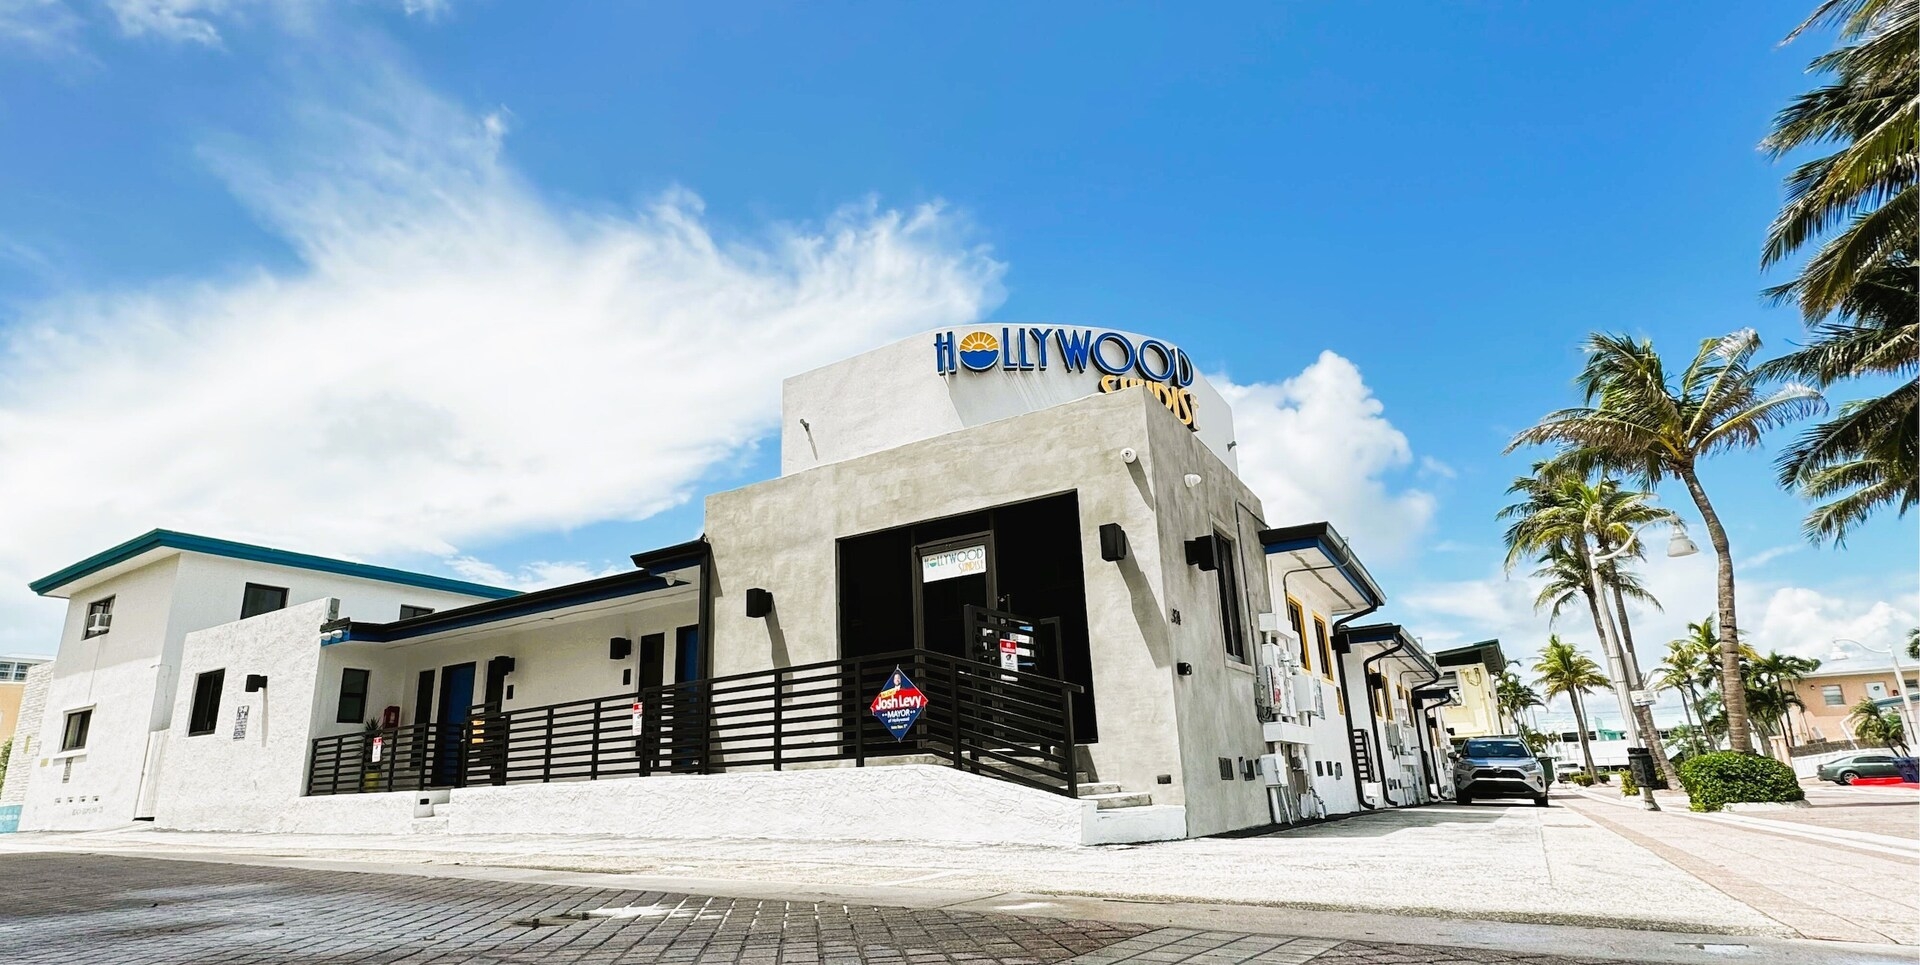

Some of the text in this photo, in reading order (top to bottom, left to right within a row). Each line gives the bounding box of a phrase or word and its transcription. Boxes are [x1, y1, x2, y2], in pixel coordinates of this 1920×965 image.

[934, 327, 1194, 388] HOLLYWOOD
[1099, 375, 1200, 431] SRISE
[924, 548, 983, 568] HOLLYWOOD
[875, 695, 922, 710] Josh Levy
[887, 709, 911, 718] MAYOR
